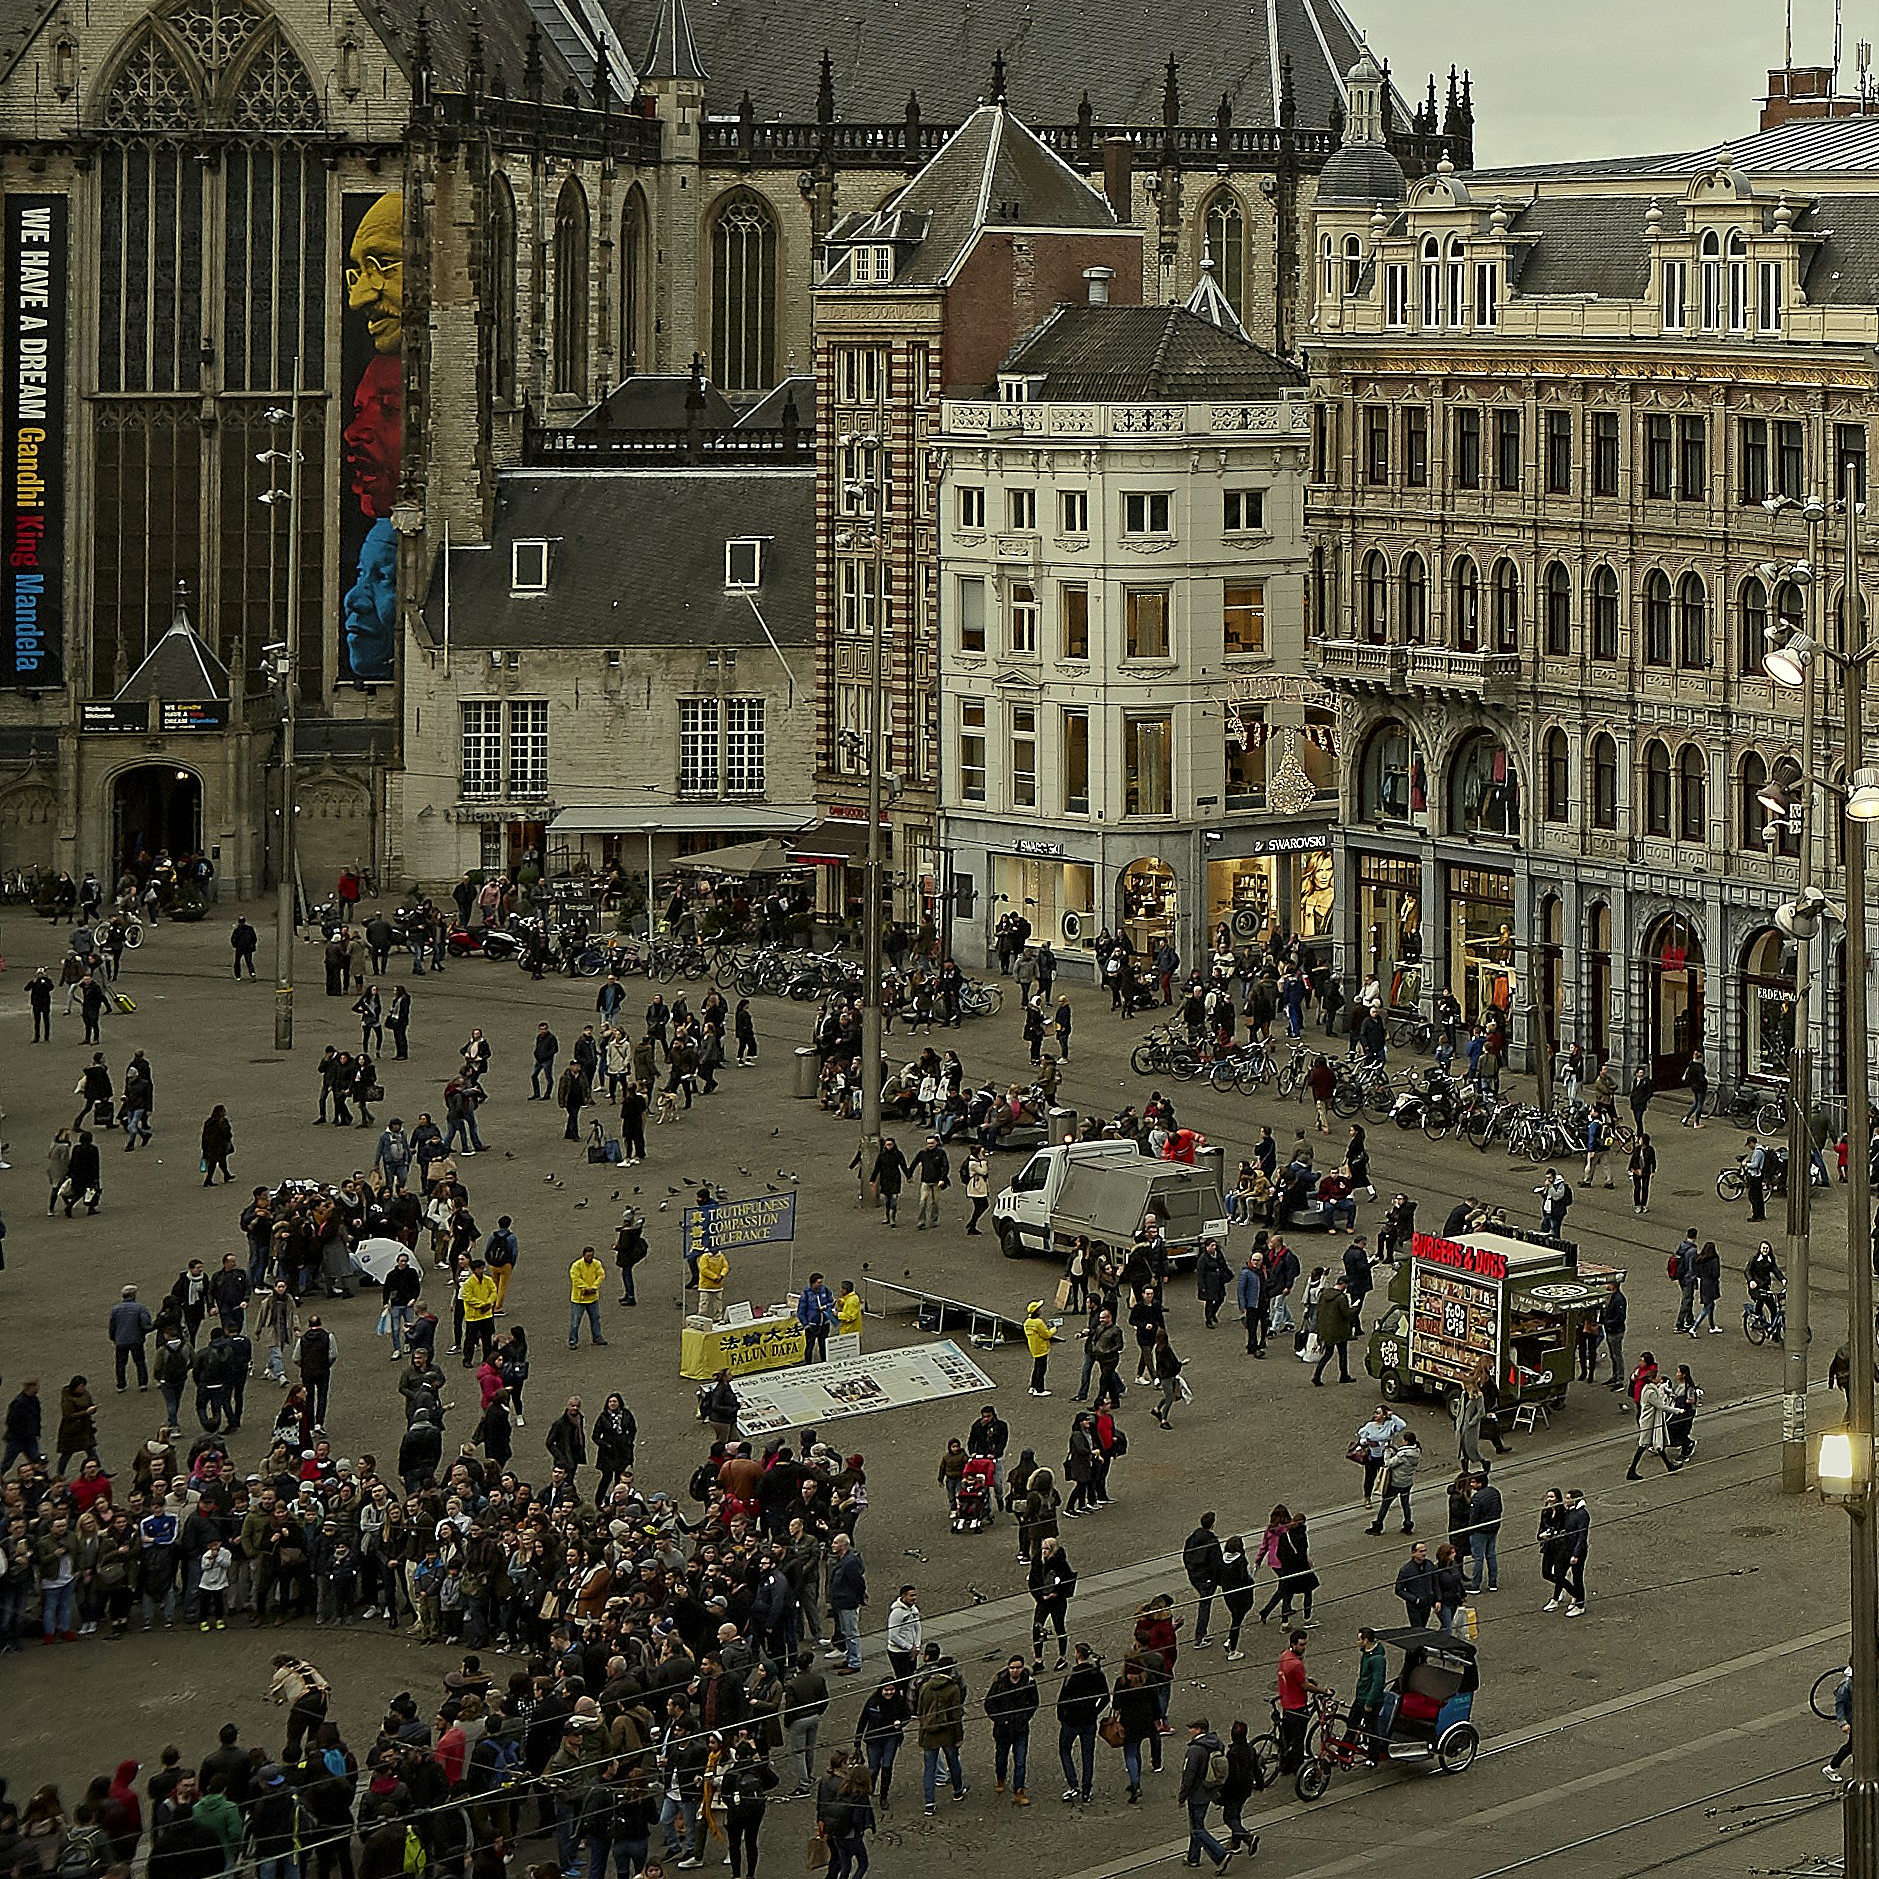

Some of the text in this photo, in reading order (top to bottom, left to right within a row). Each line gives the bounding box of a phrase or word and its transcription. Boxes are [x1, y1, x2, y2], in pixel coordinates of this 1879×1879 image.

[10, 208, 50, 671] WE HAVE A DREAM Gandhi King Mandela
[1269, 836, 1326, 851] SWAROVSKI
[709, 1197, 790, 1220] TRUTHFULNESS
[709, 1213, 778, 1234] COMPASSION
[709, 1227, 771, 1247] TOLERANCE
[1412, 1232, 1463, 1267] BURGERS
[1464, 1247, 1474, 1270] &
[1475, 1249, 1508, 1279] DOGS
[731, 1342, 799, 1365] FALUN DAFA
[760, 1374, 780, 1385] Stop
[834, 1361, 842, 1369] of
